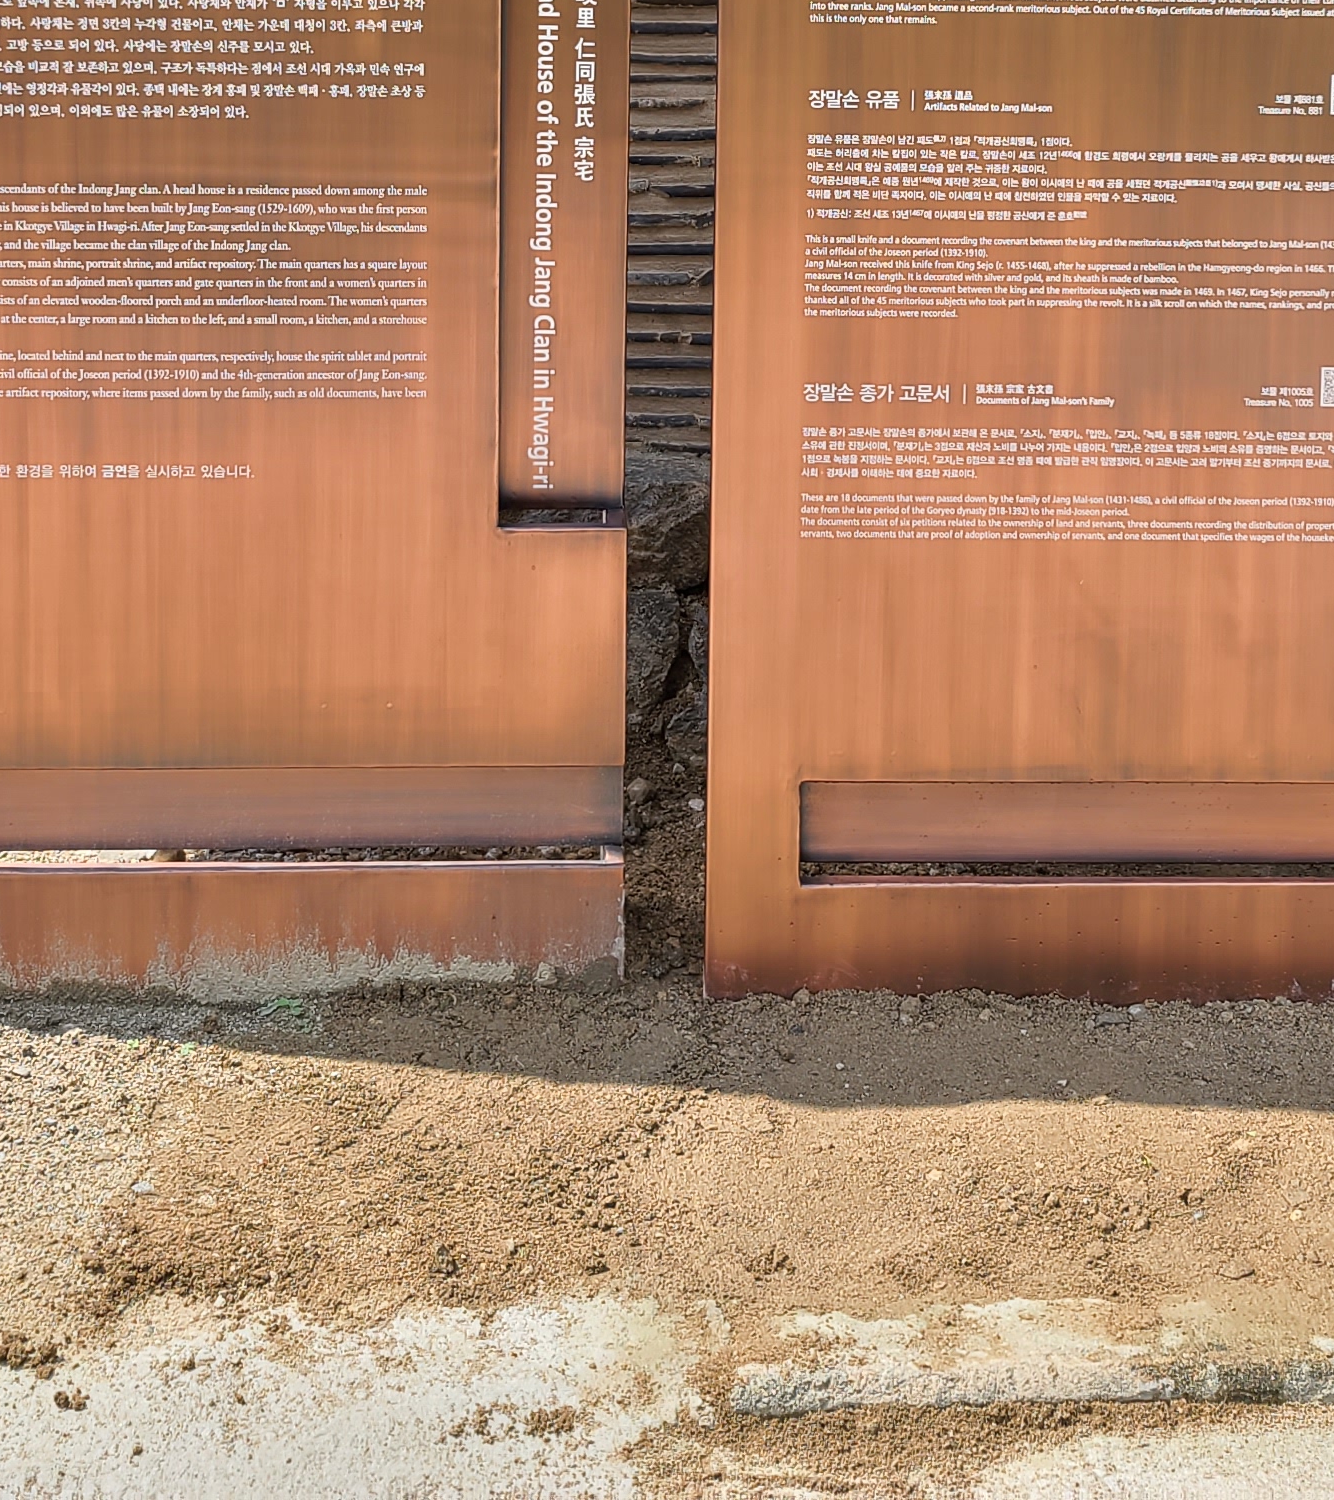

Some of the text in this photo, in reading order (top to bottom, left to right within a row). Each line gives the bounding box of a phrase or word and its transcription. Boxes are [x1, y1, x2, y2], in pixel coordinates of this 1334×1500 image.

[809, 13, 824, 22] this
[833, 13, 847, 23] the
[848, 13, 867, 25] only
[885, 14, 902, 23] that
[903, 14, 937, 24] remains.
[537, 26, 559, 94] House
[574, 37, 596, 129] 仁同張氏
[808, 89, 900, 109] 장말손 유품
[923, 101, 958, 111] Artifacts
[959, 102, 989, 111] Related
[1000, 102, 1019, 113] Jang
[1020, 102, 1052, 112] Mal-son
[537, 100, 558, 123] of
[536, 128, 558, 167] the
[573, 137, 595, 182] 宗宅
[47, 182, 59, 194] of
[60, 182, 76, 194] the
[78, 182, 113, 197] Indong
[114, 184, 137, 197] Jang
[138, 183, 161, 194] clan.
[172, 183, 195, 194] head
[197, 183, 225, 194] house
[245, 184, 289, 195] residence
[291, 184, 322, 198] passed
[324, 184, 350, 195] down
[352, 187, 385, 198] among
[387, 184, 402, 195] the
[404, 184, 427, 196] male
[530, 174, 557, 251] Indong
[530, 259, 556, 308] Jang
[533, 315, 556, 363] Clan
[533, 370, 555, 388] in
[803, 383, 949, 403] 장말손 종가 고문서
[975, 395, 1020, 405] Documents
[1030, 396, 1050, 407] Jang
[1051, 396, 1088, 405] Mal-son's
[1088, 396, 1114, 407] Family
[527, 395, 554, 489] Hwagi-ri
[15, 464, 53, 478] 환경을
[58, 464, 96, 478] 위하여
[101, 464, 140, 478] 금연을
[144, 464, 195, 478] 실시하고
[200, 464, 254, 478] 있습니다.
